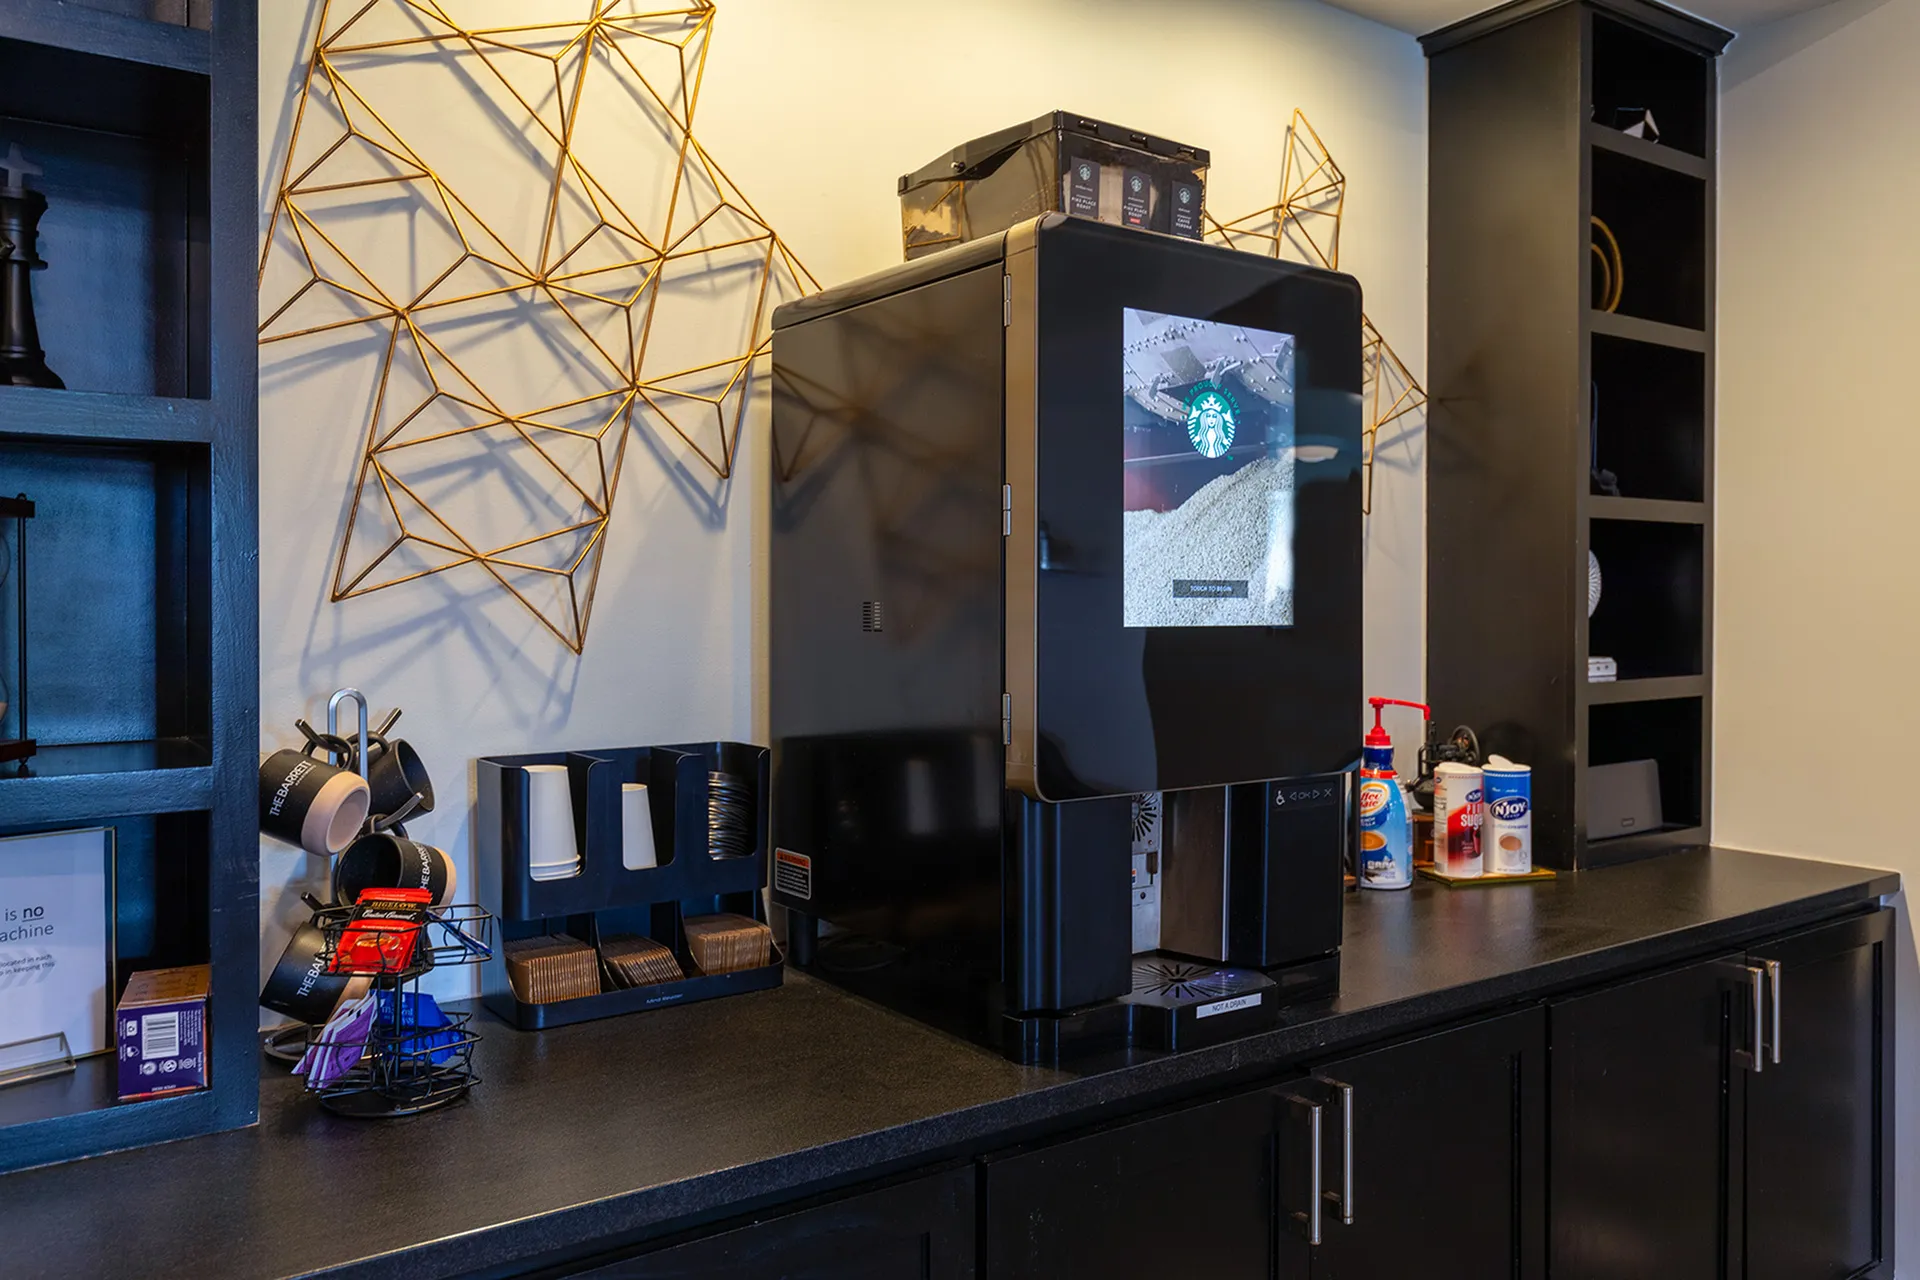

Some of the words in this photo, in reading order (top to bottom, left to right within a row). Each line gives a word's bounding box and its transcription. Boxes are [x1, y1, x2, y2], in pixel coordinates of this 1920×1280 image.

[276, 760, 312, 798] BARRETT
[269, 796, 285, 816] THE
[5, 908, 17, 921] is
[22, 905, 44, 922] no
[371, 901, 417, 909] BIGELOW
[0, 924, 54, 943] achine
[296, 976, 316, 997] THE
[1211, 1002, 1225, 1012] NOT
[1230, 999, 1248, 1009] DRAIN
